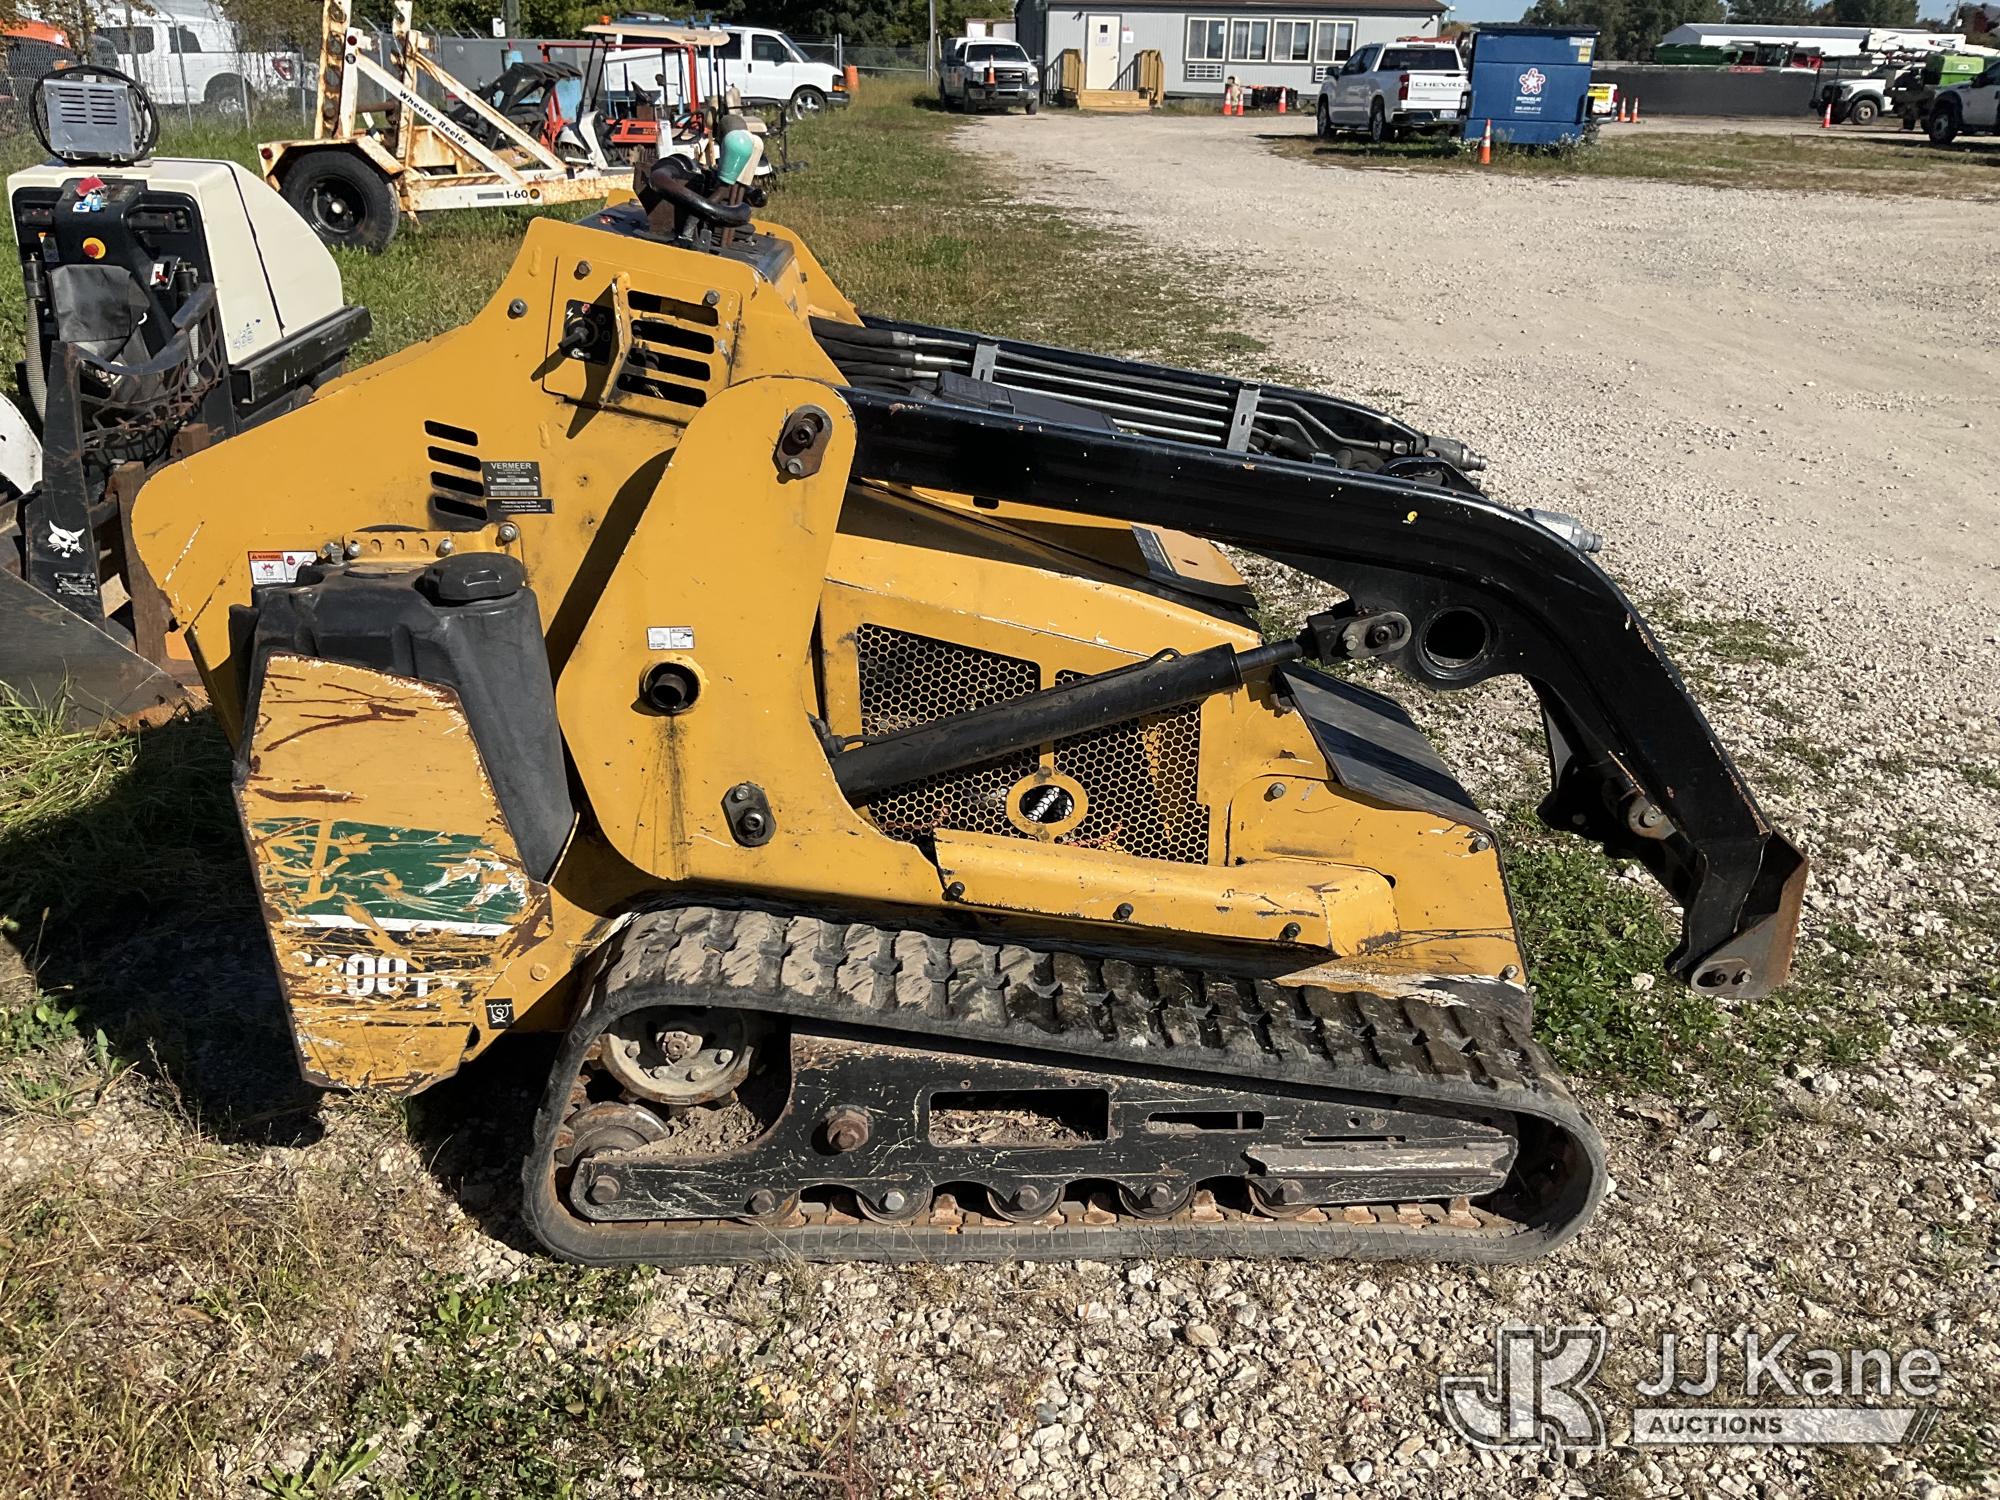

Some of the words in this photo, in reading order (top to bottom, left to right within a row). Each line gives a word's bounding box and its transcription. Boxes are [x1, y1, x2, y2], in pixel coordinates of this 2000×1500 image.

[399, 90, 437, 121] Wheeler
[438, 121, 468, 145] Reeler
[490, 462, 532, 470] VERMEER
